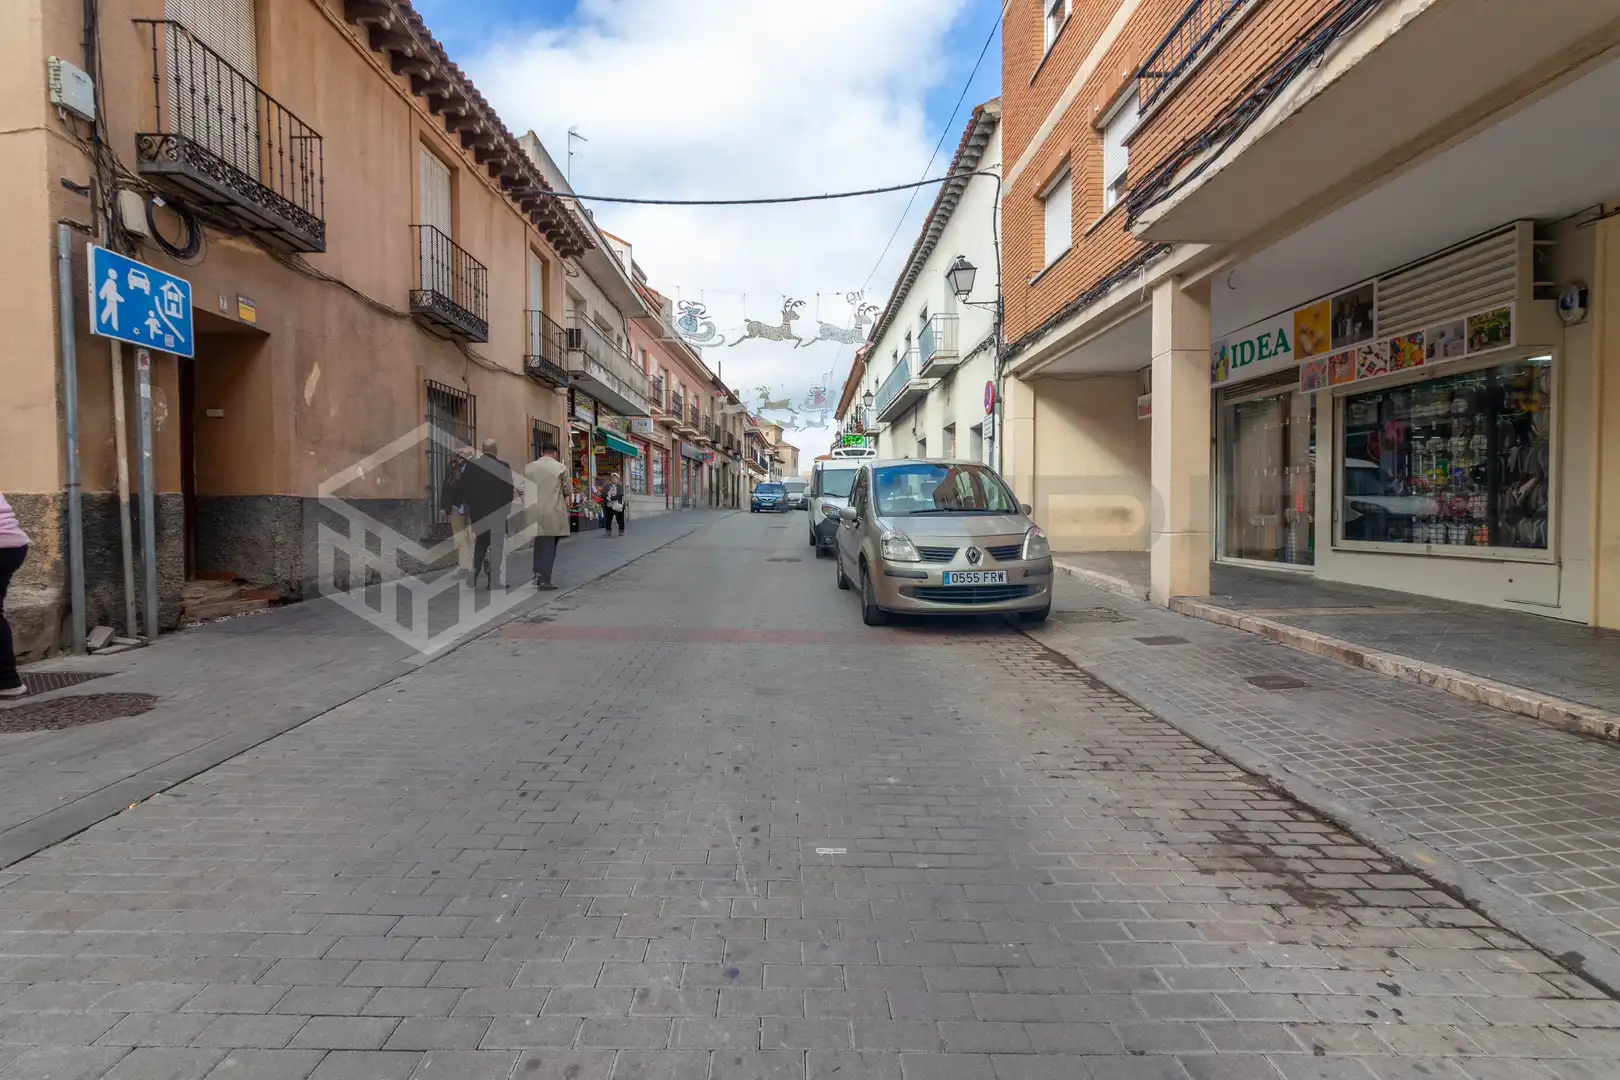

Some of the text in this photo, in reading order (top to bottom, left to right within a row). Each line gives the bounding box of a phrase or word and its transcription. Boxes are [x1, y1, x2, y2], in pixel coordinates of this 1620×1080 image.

[1231, 327, 1292, 369] IDEA
[951, 571, 1004, 584] 0555 FRW
